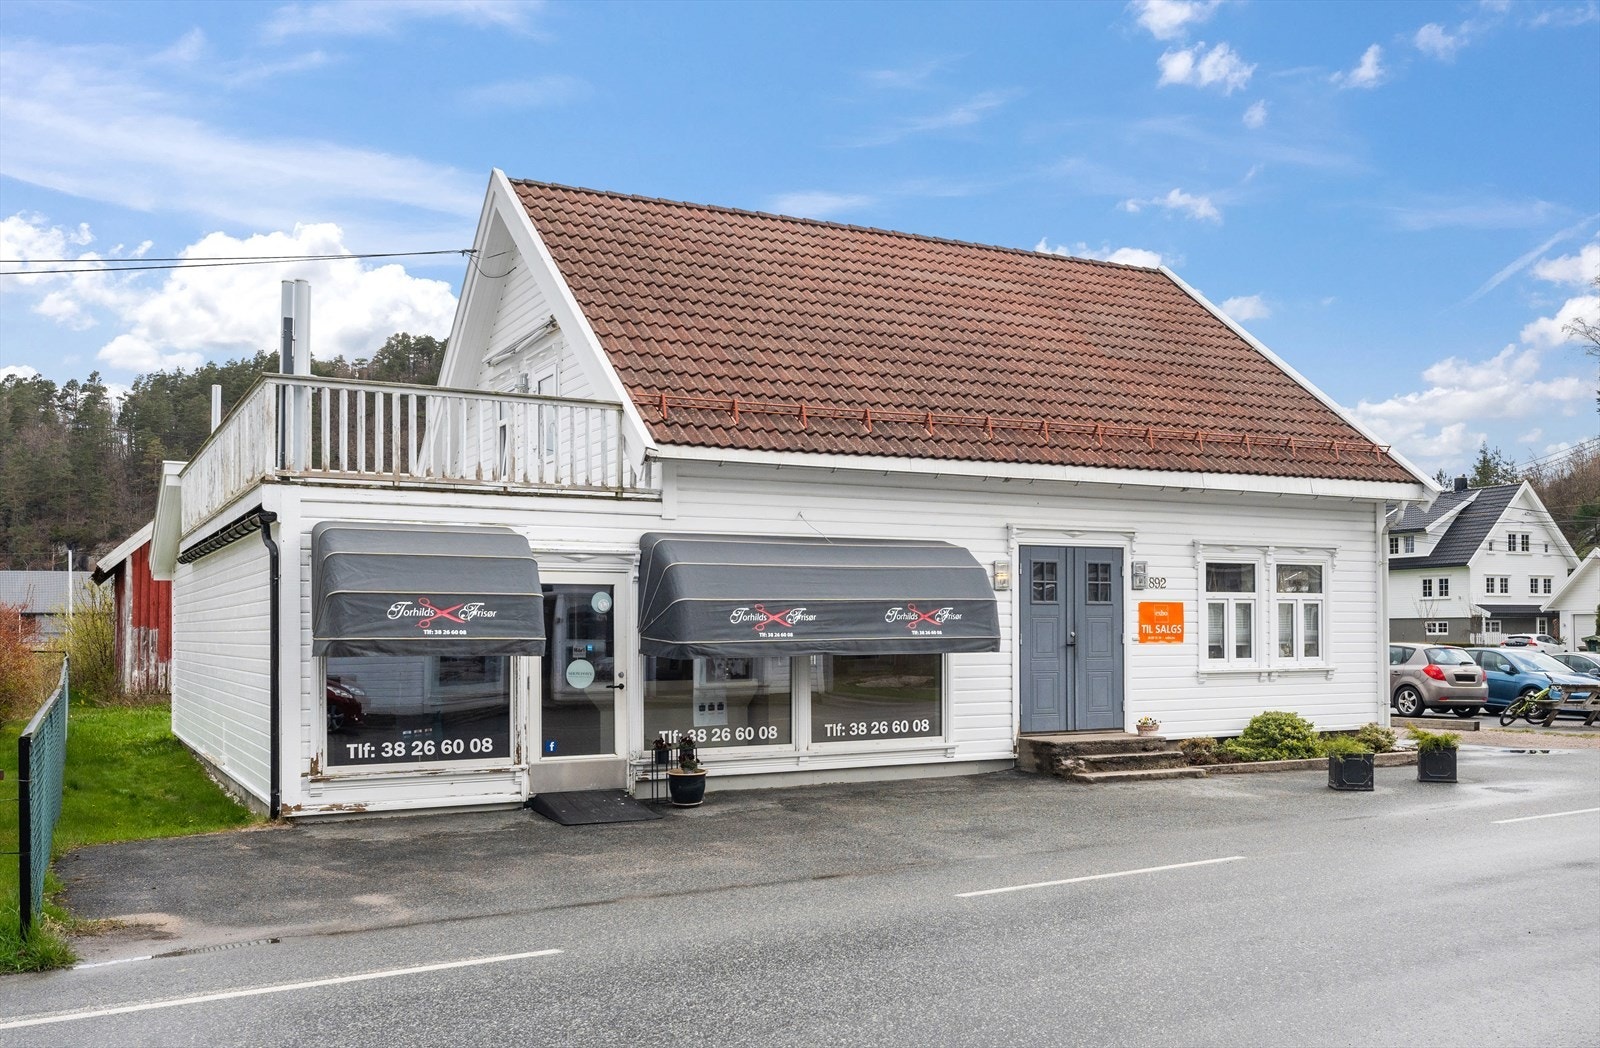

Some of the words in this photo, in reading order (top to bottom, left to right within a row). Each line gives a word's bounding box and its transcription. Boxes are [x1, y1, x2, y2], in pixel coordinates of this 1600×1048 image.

[1148, 577, 1167, 589] 892
[387, 601, 434, 620] Torhilds
[458, 602, 497, 621] Frisør
[730, 607, 767, 624] Torhilds
[786, 607, 817, 624] Frisør
[885, 607, 918, 623] Torhilds
[1141, 624, 1153, 634] TIL
[1155, 624, 1182, 634] SALGS
[687, 728, 707, 742] 38
[711, 728, 731, 742] 26
[735, 726, 755, 740] 60
[758, 725, 778, 739] 08
[824, 723, 845, 737] Tlf:
[849, 722, 867, 736] 38
[870, 721, 888, 734] 26
[892, 720, 909, 733] 60
[912, 719, 930, 732] 08
[346, 742, 375, 759] Tlf:
[381, 741, 406, 757] 38
[411, 740, 436, 755] 26
[440, 739, 465, 754] 60
[469, 737, 493, 753] 08
